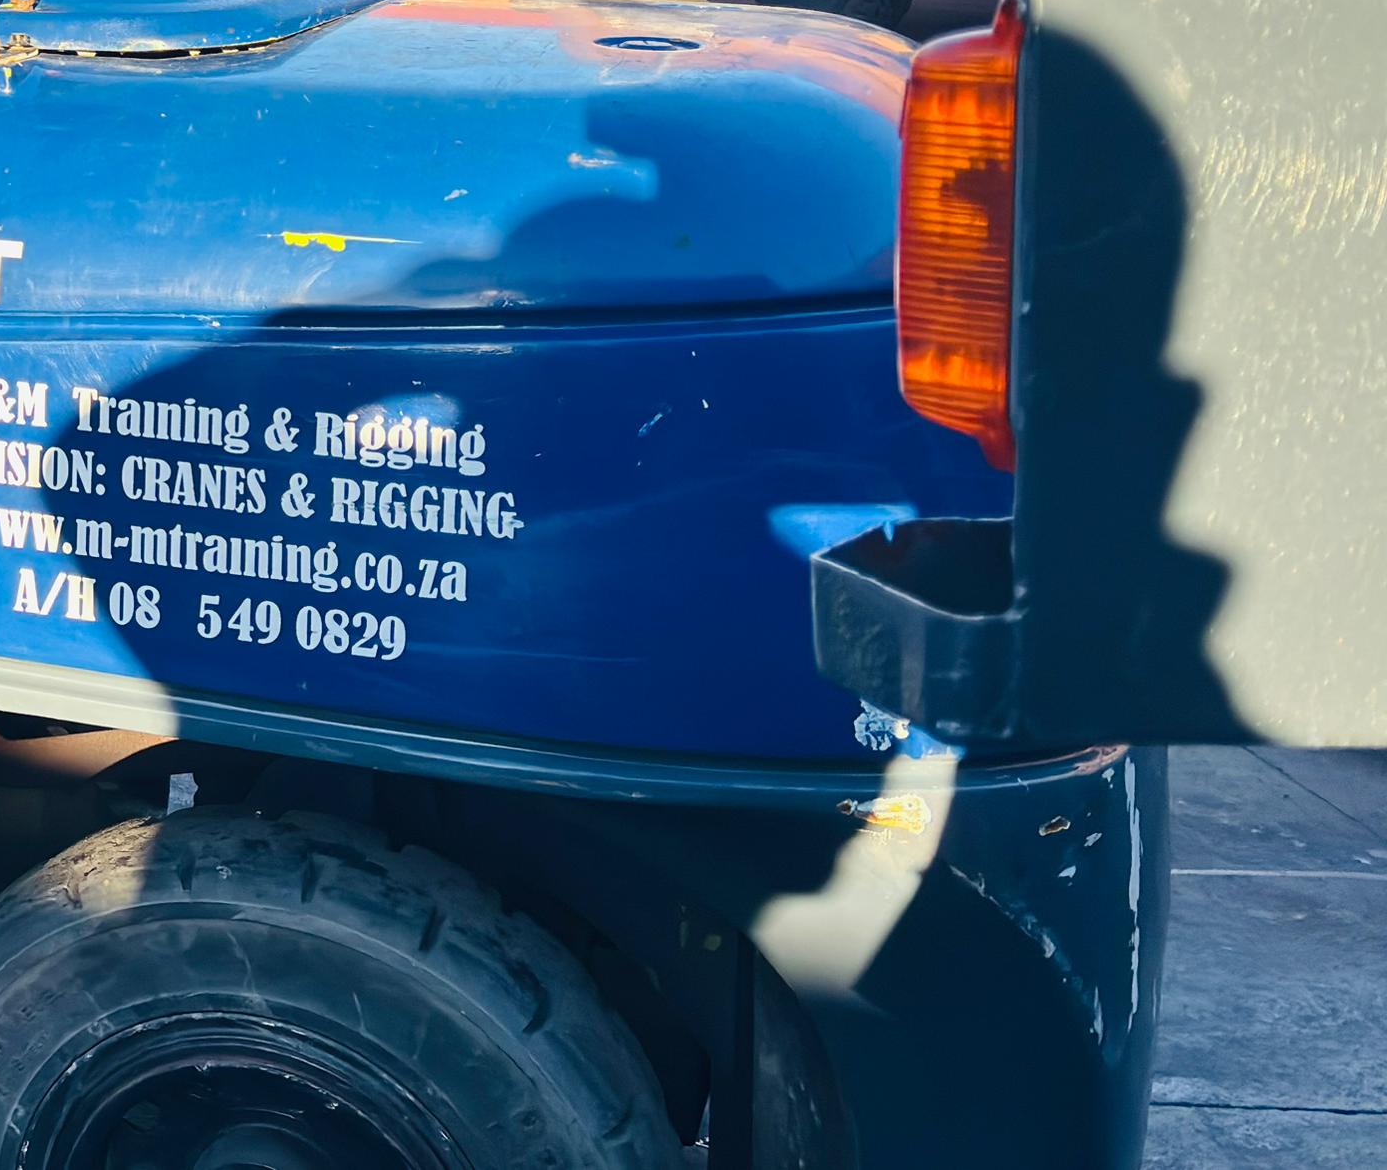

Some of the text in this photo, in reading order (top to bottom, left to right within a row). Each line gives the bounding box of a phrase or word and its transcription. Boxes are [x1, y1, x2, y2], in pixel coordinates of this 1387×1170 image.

[72, 387, 250, 454] Training
[264, 407, 300, 453] &
[313, 411, 487, 476] Rigging
[121, 455, 267, 514] CRANES
[280, 472, 316, 519] &
[330, 477, 525, 539] RIGGING
[12, 566, 406, 662] A/H 08 549 0829
